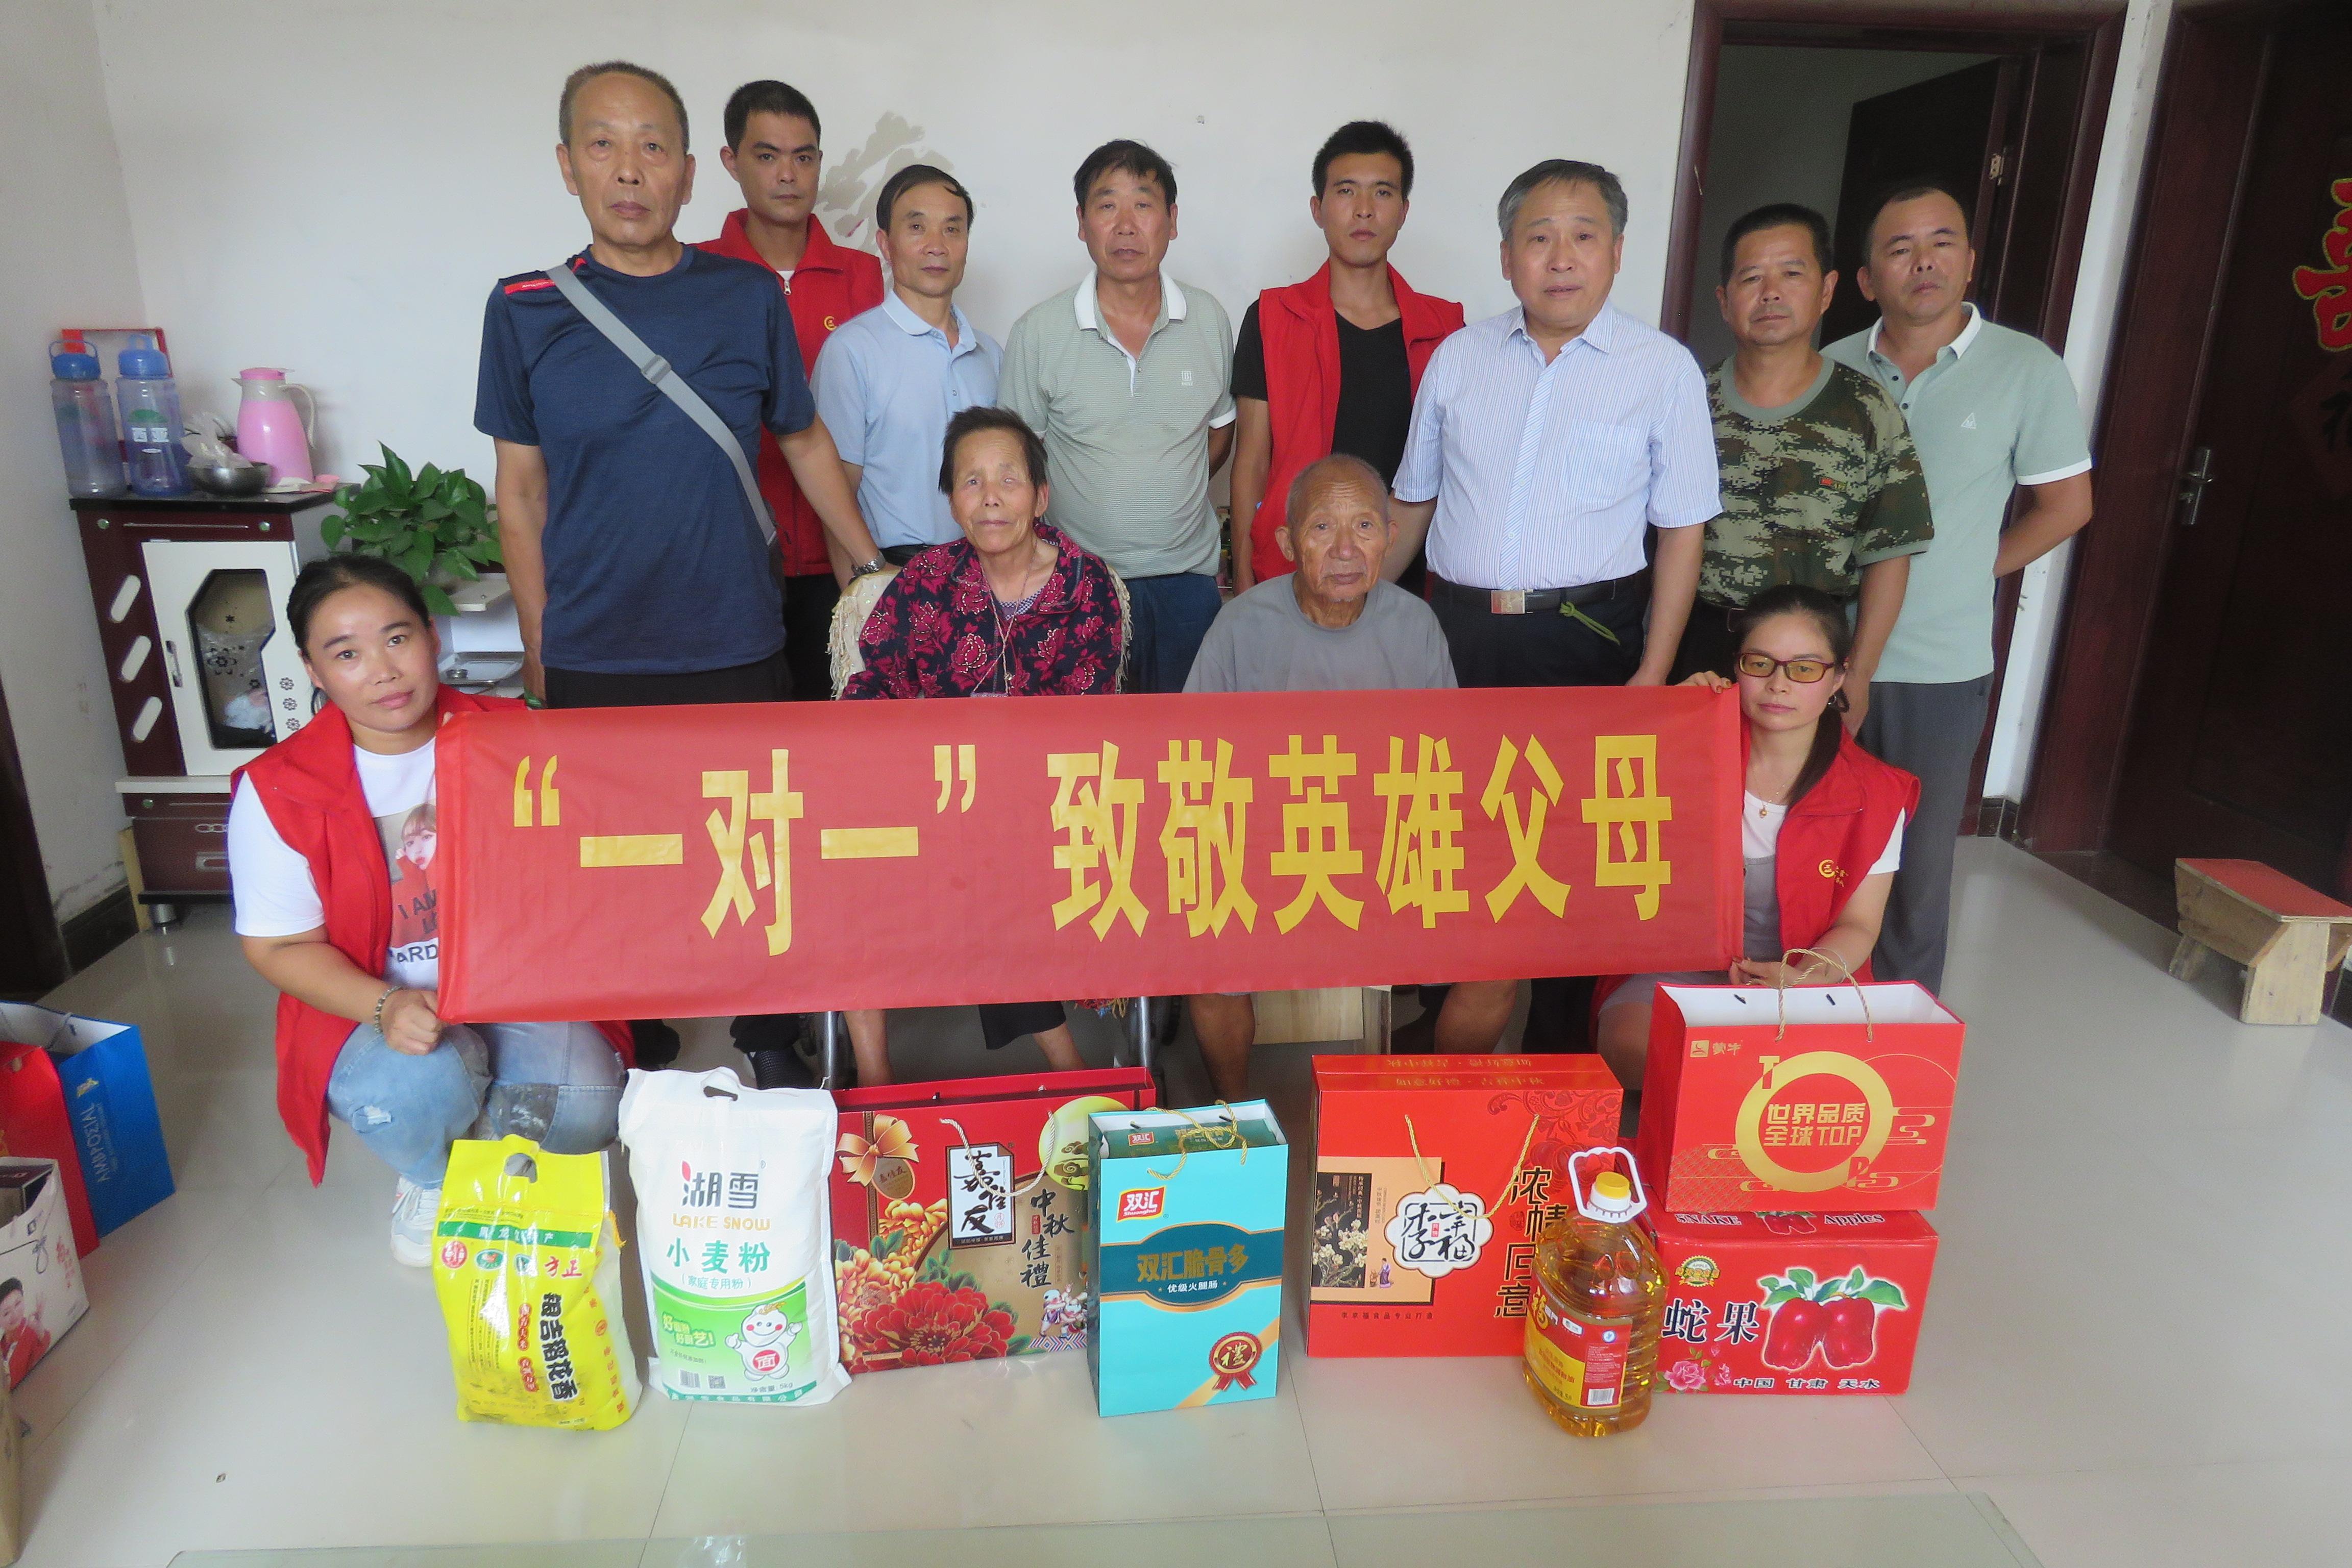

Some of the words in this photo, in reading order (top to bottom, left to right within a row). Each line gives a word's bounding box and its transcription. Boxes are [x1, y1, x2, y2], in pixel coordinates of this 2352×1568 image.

[512, 743, 976, 955] “一对一”
[1046, 733, 1673, 942] 致敬英雄父母
[398, 904, 409, 919] I
[1712, 1041, 1742, 1056] 蒙牛
[1767, 1102, 1866, 1125] 世界品质
[681, 1161, 758, 1210] 湖雪
[1123, 1191, 1160, 1211] 双汇
[672, 1213, 717, 1230] LAKE
[723, 1217, 771, 1231] SNOW
[1123, 1208, 1157, 1217] Shuanghui
[1675, 1213, 1742, 1226] SNAKE
[1824, 1213, 1885, 1227] Apples
[544, 1255, 582, 1278] 方正
[666, 1240, 770, 1275] 小麦粉
[1137, 1243, 1250, 1283] 双汇脆骨多
[1167, 1280, 1218, 1293] 优级火腿肠
[1661, 1298, 1760, 1345] 蛇果
[1733, 1377, 1775, 1389] 中国
[1785, 1377, 1828, 1389] 甘肃
[1837, 1377, 1880, 1389] 天水
